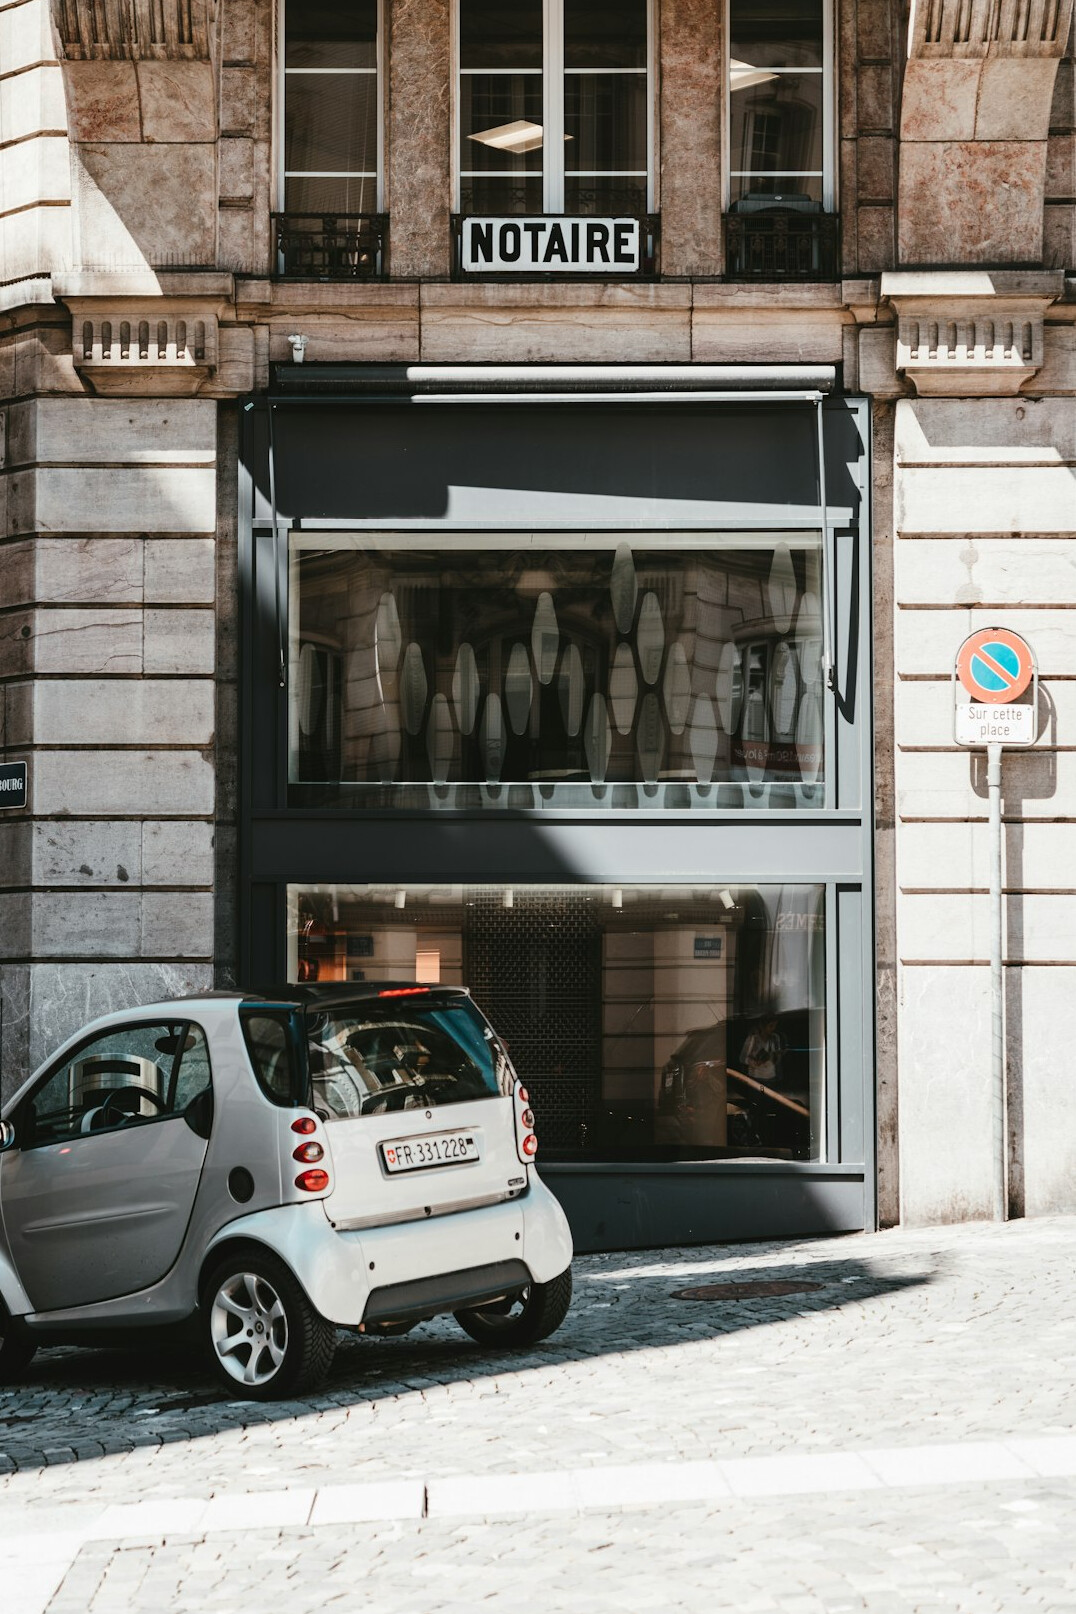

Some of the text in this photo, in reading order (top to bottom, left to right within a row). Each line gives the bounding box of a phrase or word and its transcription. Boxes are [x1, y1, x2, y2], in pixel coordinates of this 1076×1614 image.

[470, 222, 635, 264] NOTAIRE
[968, 706, 1022, 721] Sur cette
[980, 722, 1010, 739] place
[0, 777, 24, 792] OURG
